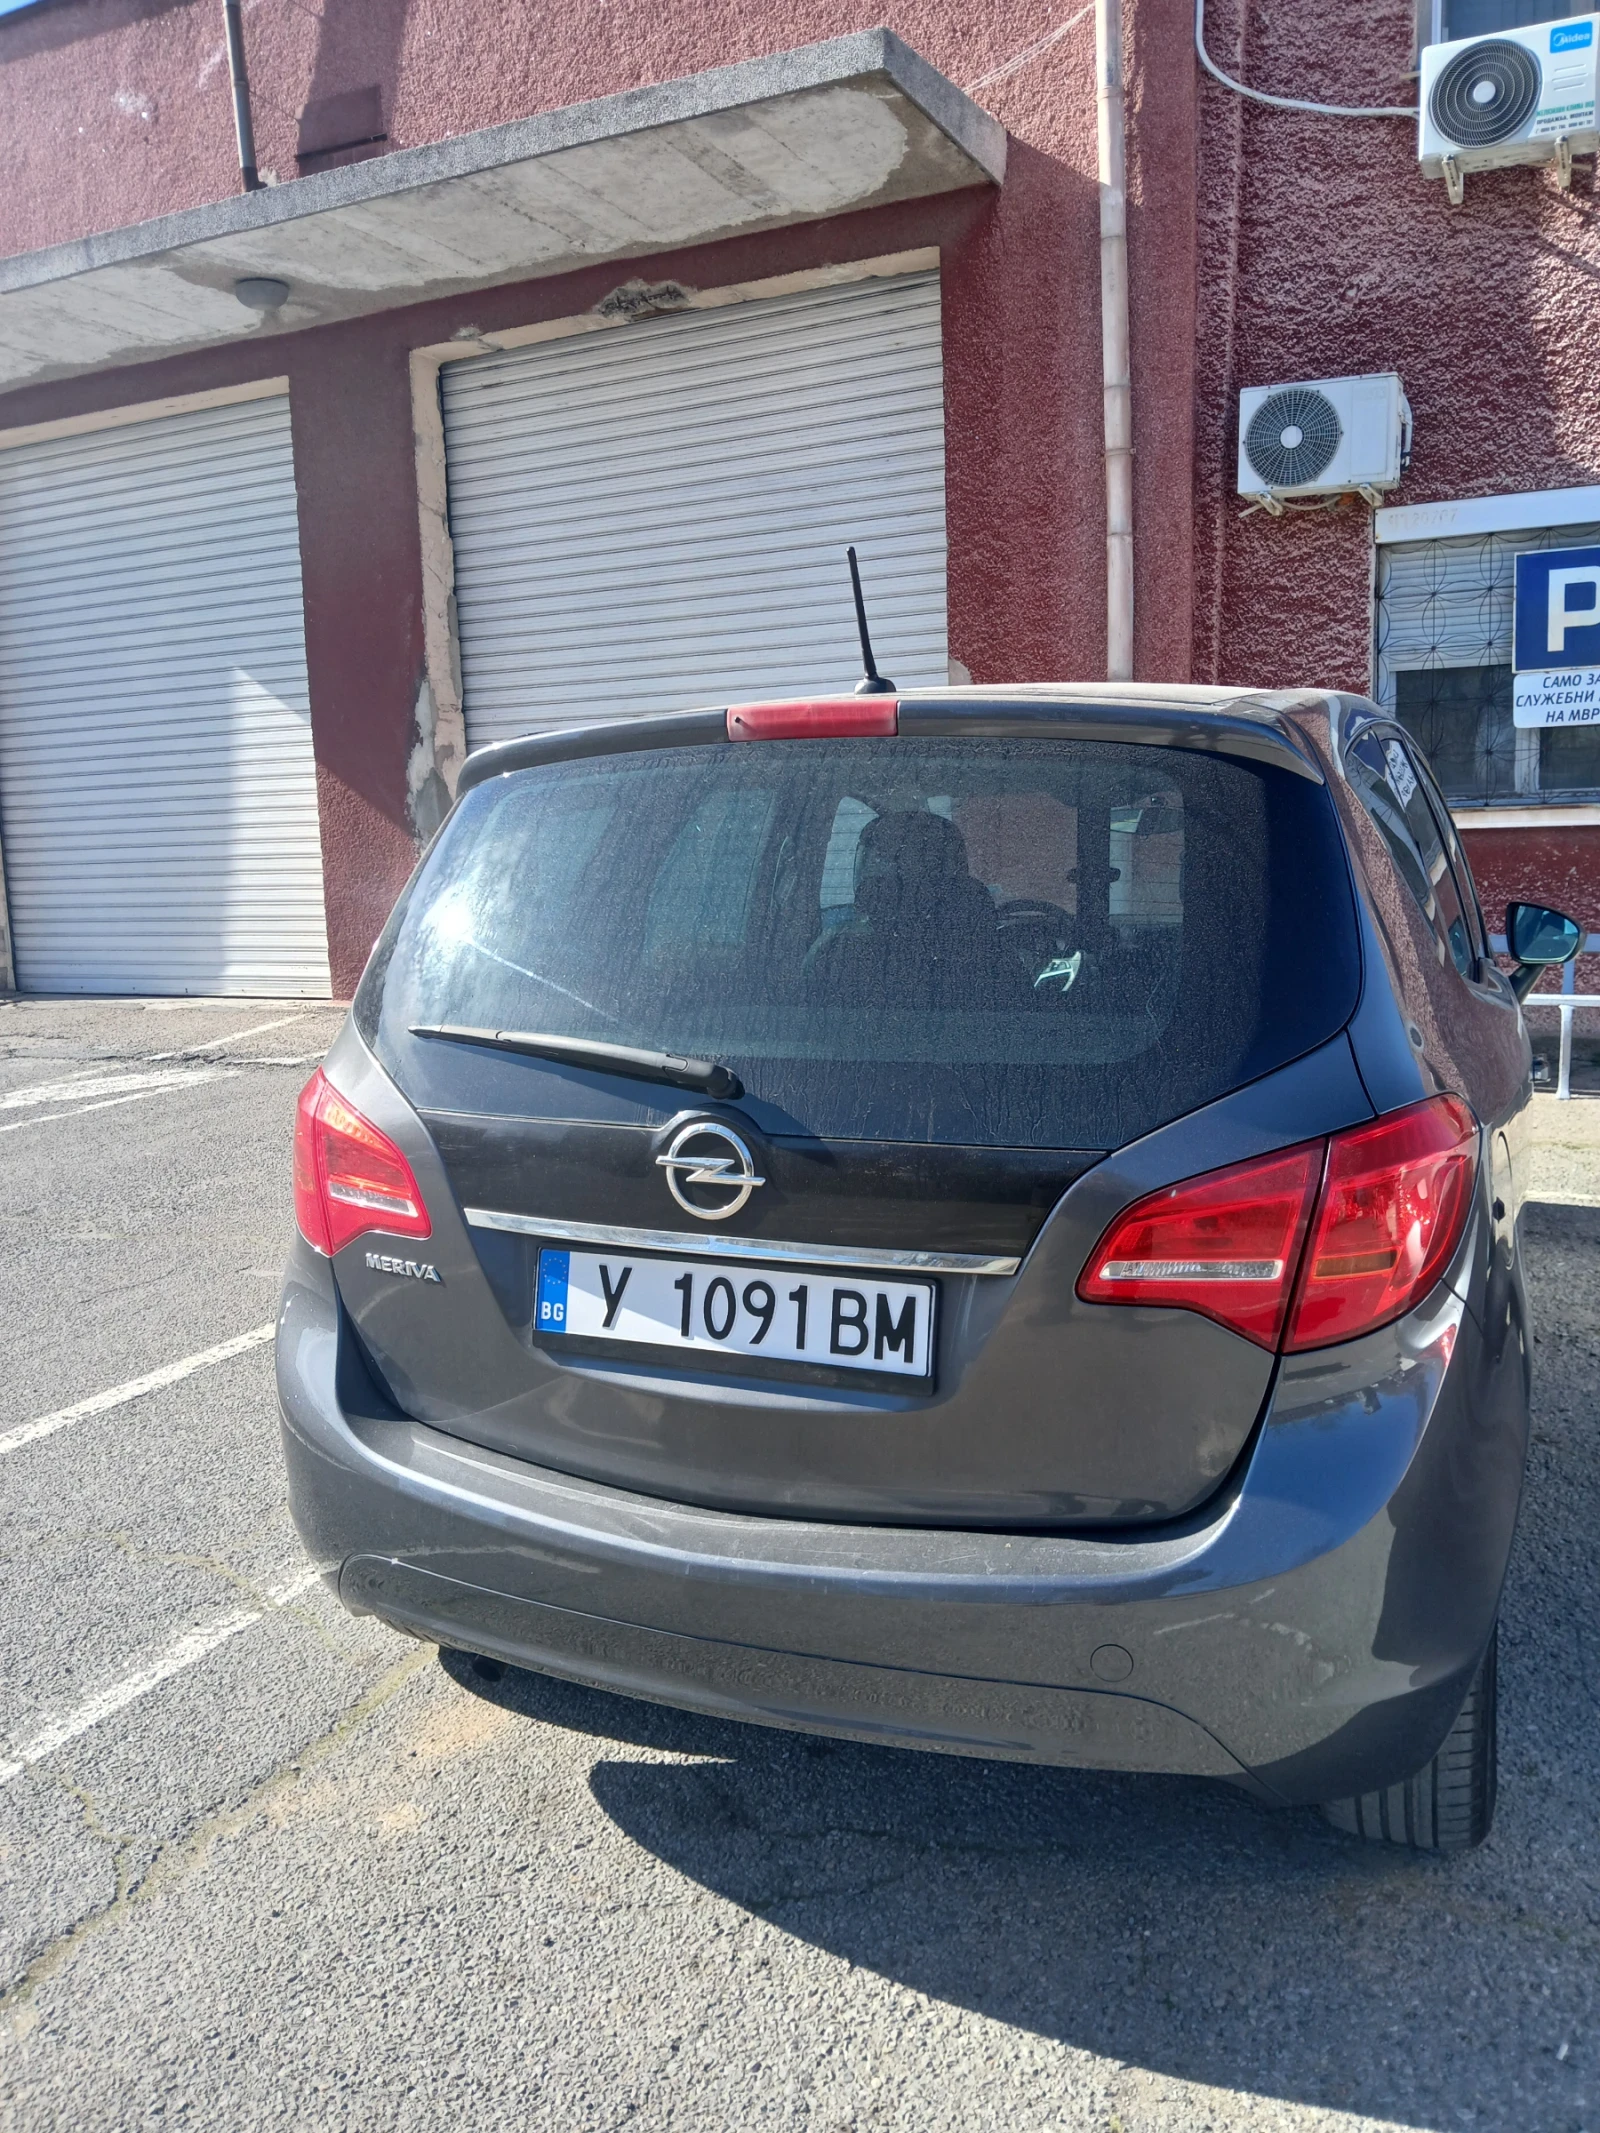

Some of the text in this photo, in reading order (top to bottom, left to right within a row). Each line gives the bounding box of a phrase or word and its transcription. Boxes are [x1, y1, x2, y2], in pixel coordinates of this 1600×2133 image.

[1553, 32, 1590, 47] Midea
[1547, 565, 1600, 652] P
[1543, 674, 1582, 689] САМО
[1515, 690, 1595, 708] СЛУЖЕБНИ
[1545, 707, 1600, 723] НА МВР
[365, 1251, 440, 1282] MERIVA
[540, 1300, 564, 1323] BG
